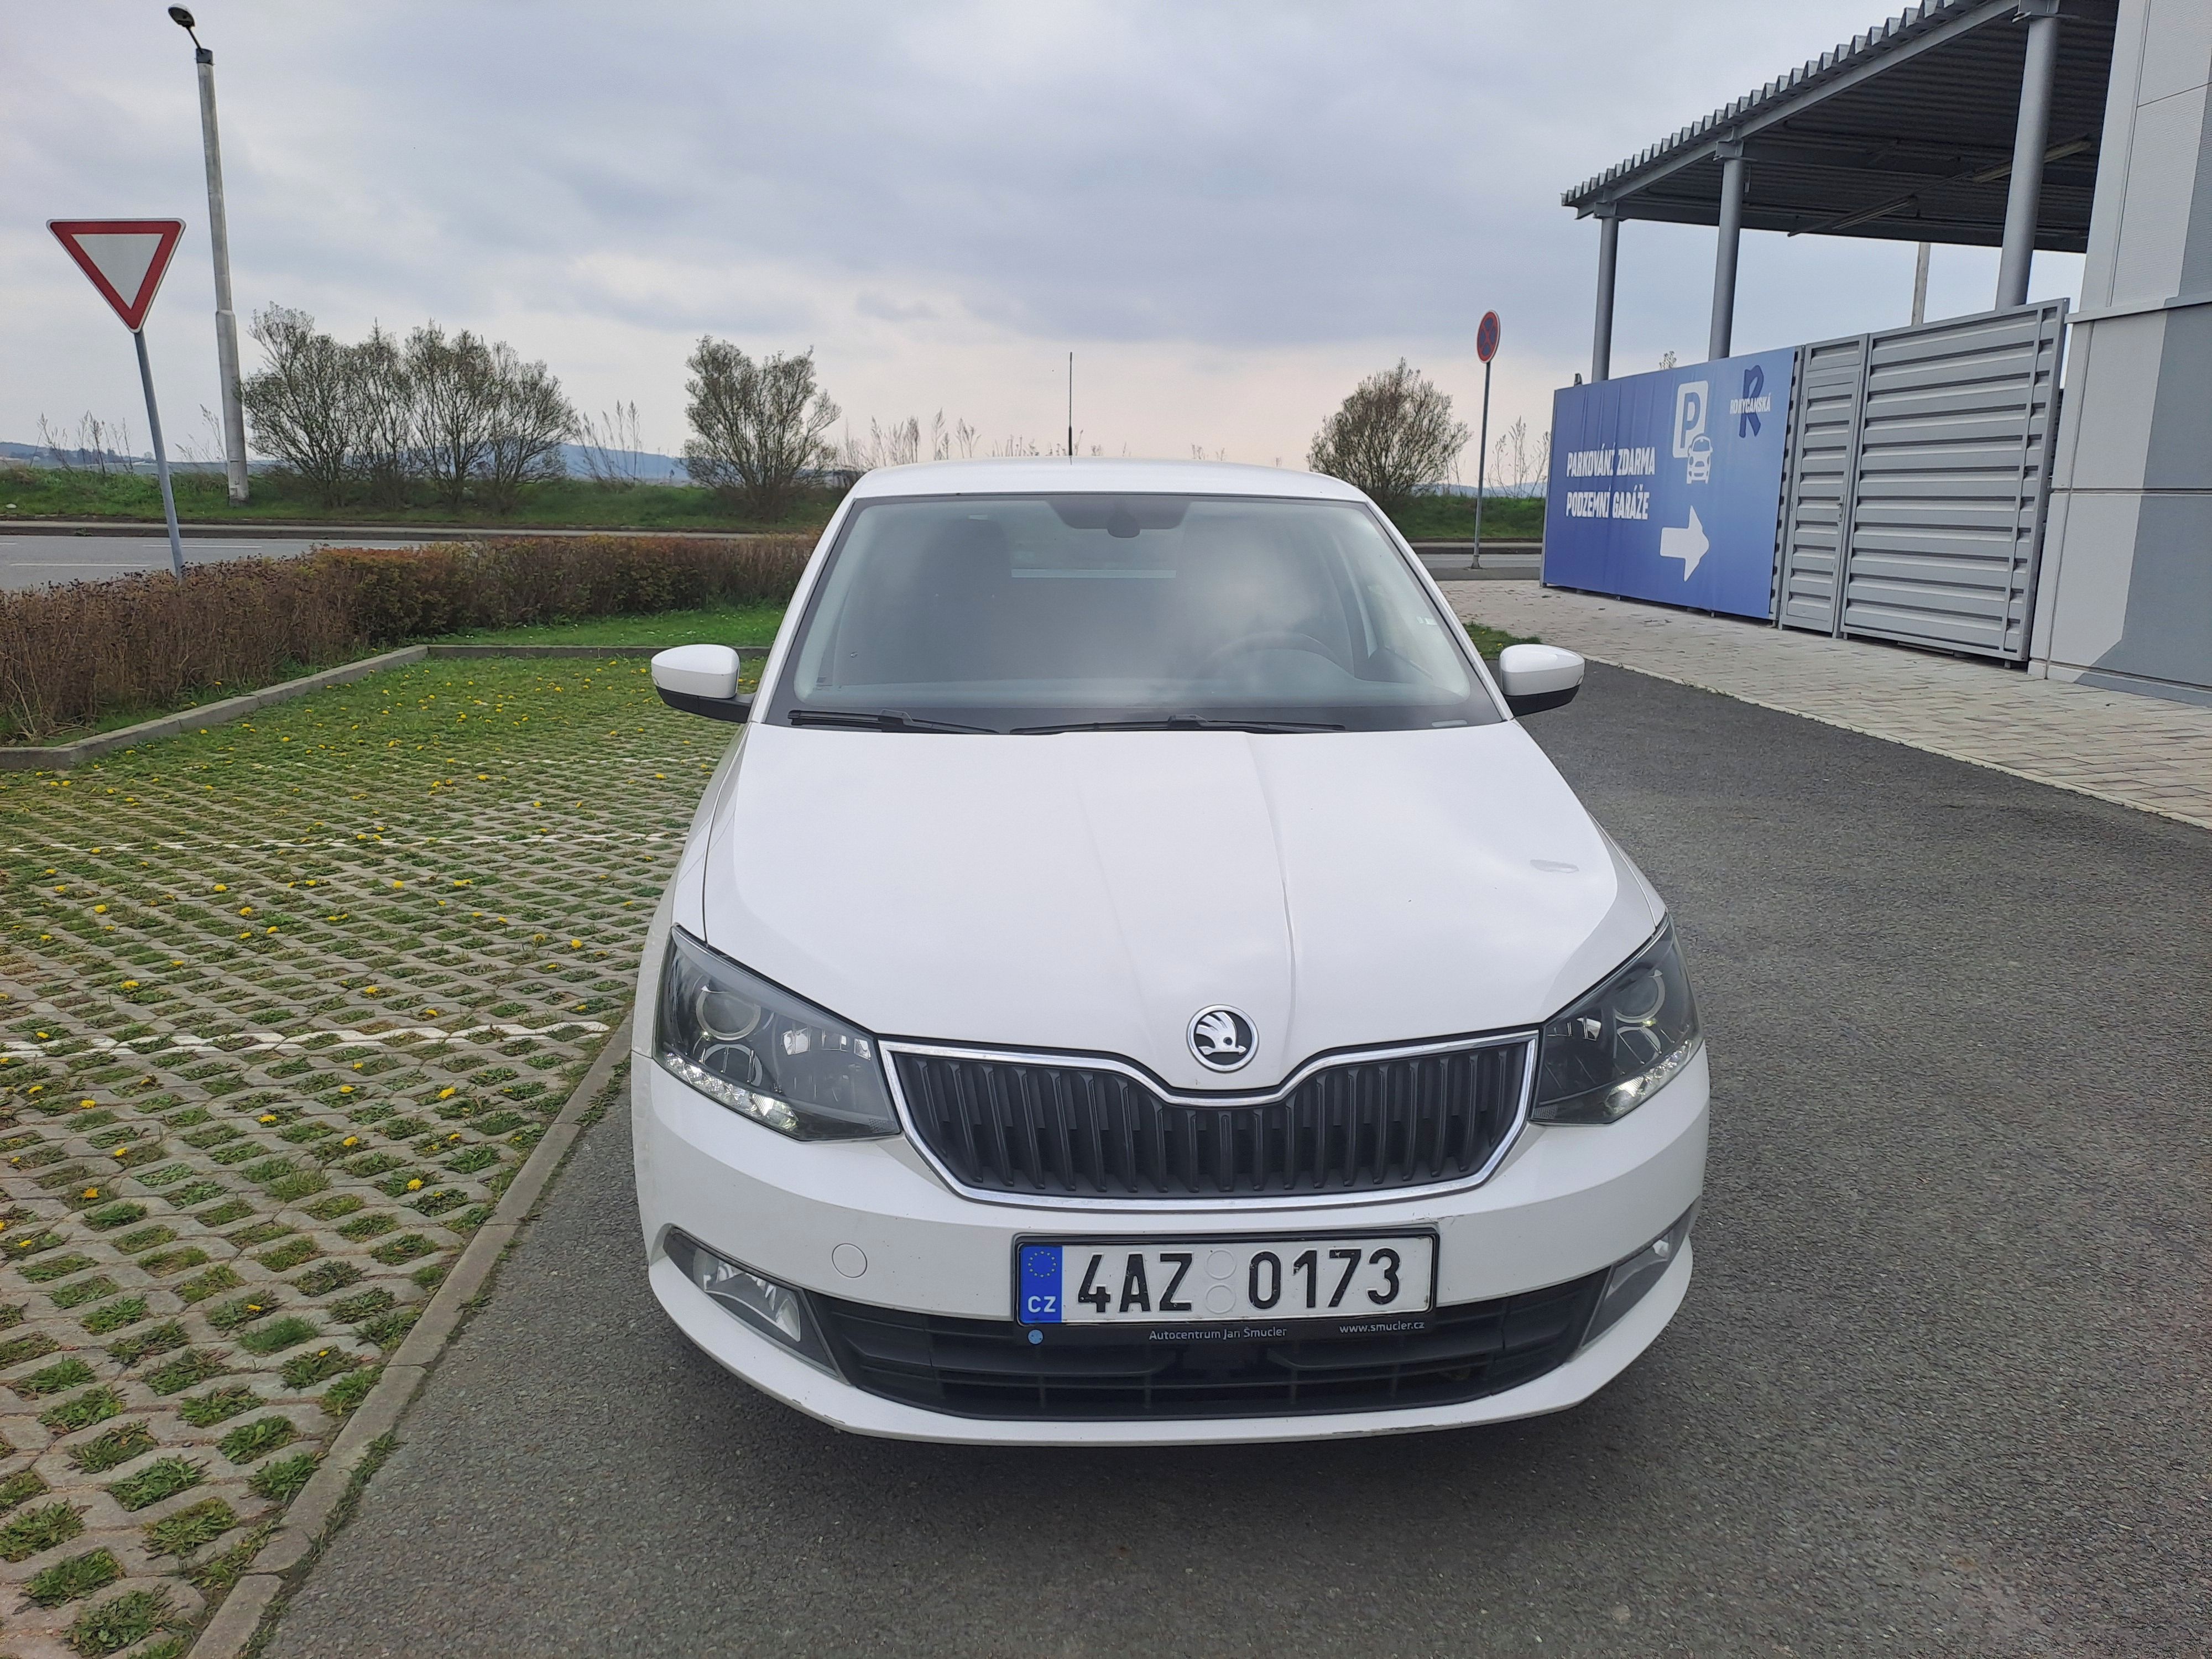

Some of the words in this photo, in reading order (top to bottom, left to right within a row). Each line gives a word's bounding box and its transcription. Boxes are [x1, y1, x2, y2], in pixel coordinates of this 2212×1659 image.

[1729, 392, 1771, 415] ROKYCANSKÁ
[1566, 442, 1616, 477] PARKOVÁNÍ
[1616, 446, 1655, 476] ZDARMA
[1566, 484, 1611, 518] PODZEMNÍ
[1612, 483, 1650, 520] GARÁŽE
[1078, 1253, 1193, 1313] 4AZ
[1249, 1247, 1401, 1310] 0173
[1027, 1296, 1056, 1313] CZ
[1149, 1329, 1220, 1340] Autocentrum
[1222, 1328, 1241, 1340] Jan
[1243, 1327, 1287, 1338] Šmucler
[1339, 1321, 1426, 1334] www.smucler.cz
